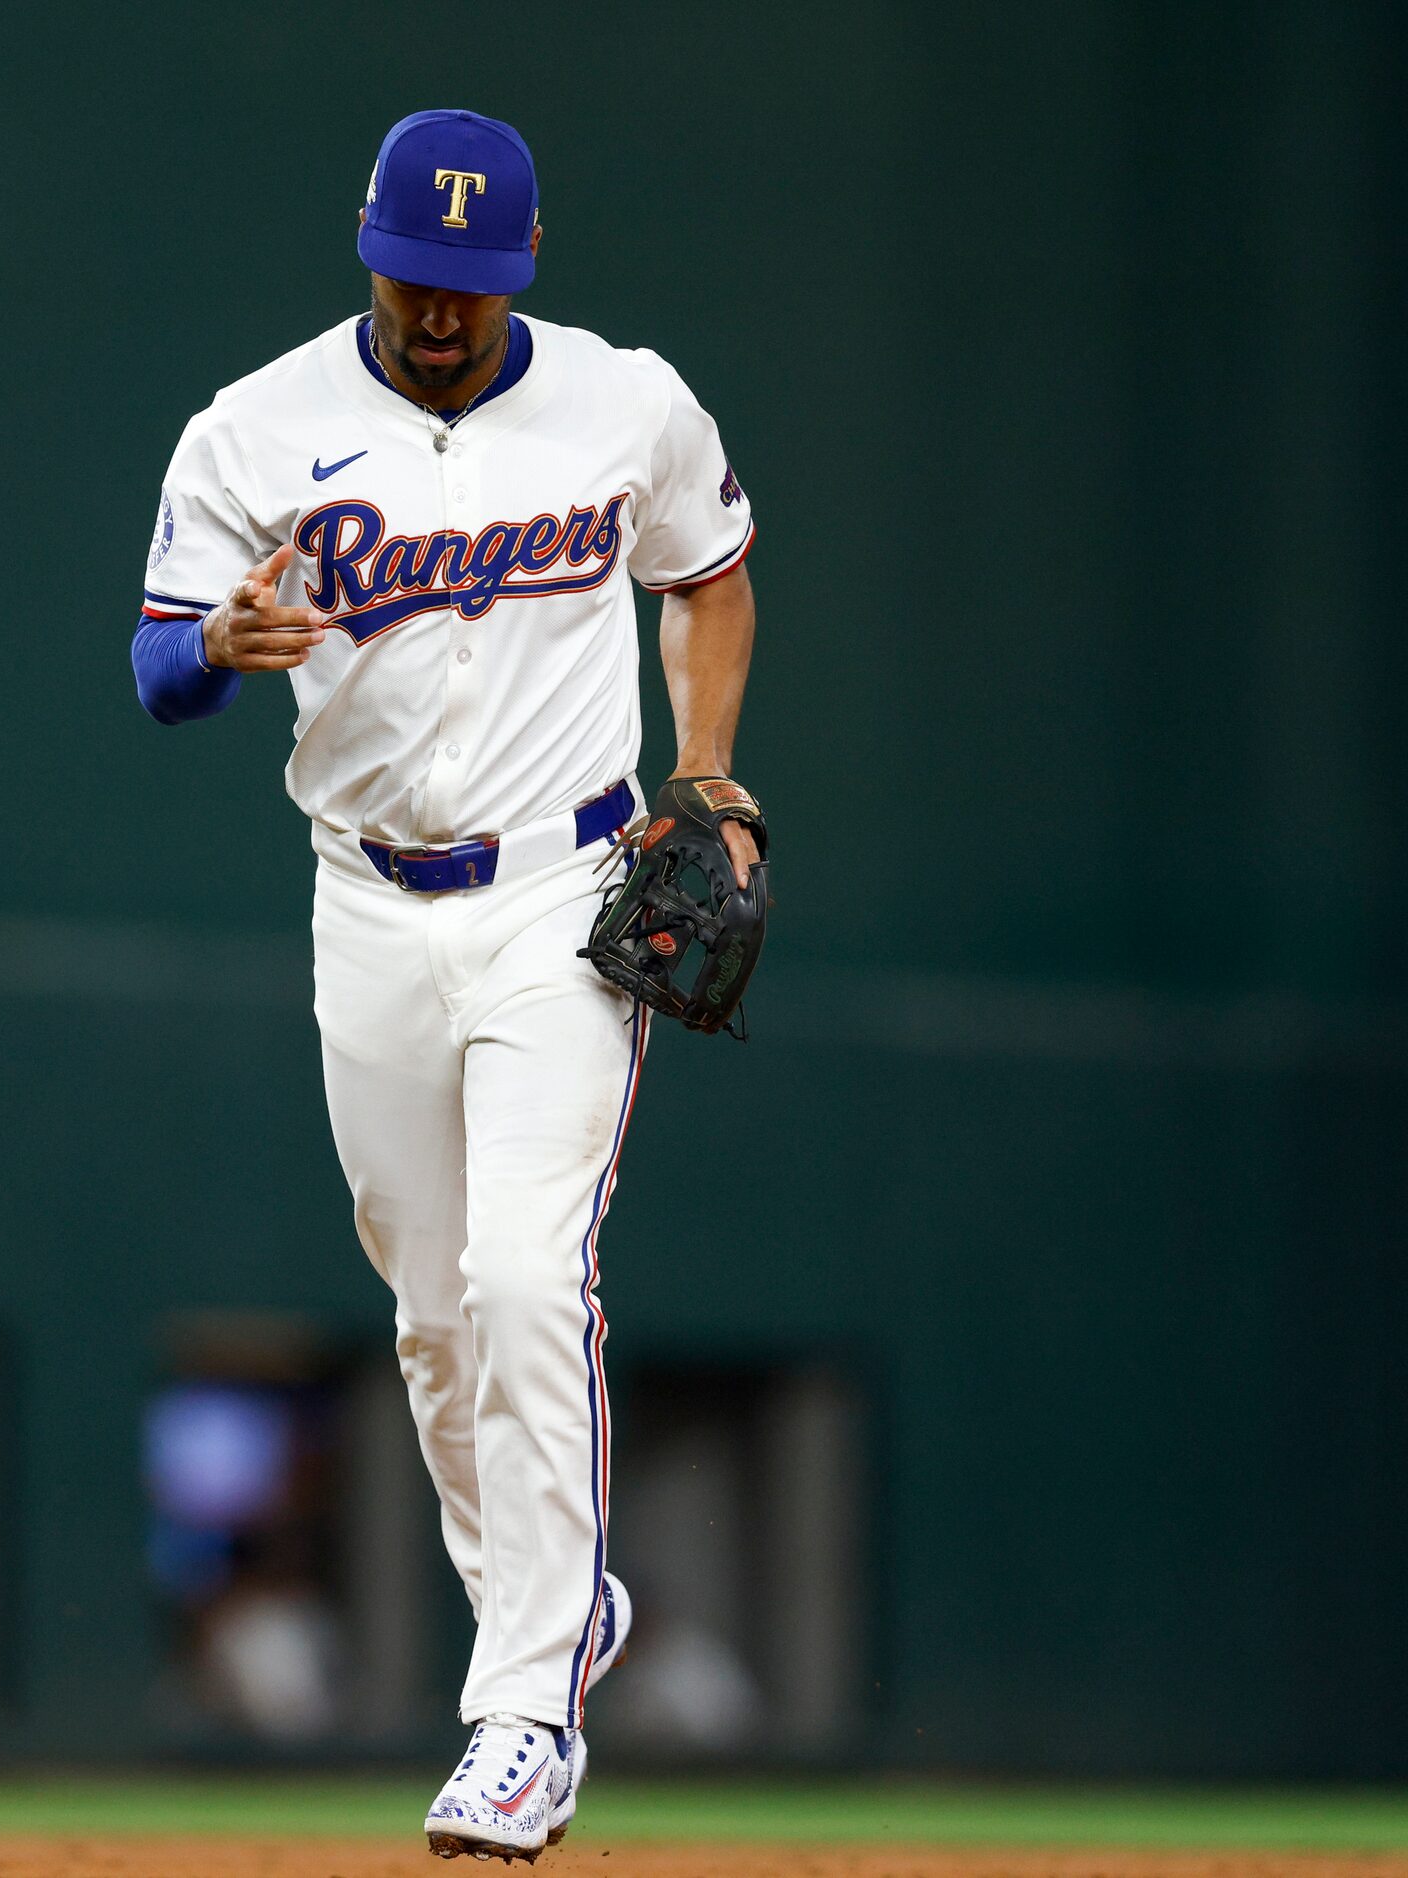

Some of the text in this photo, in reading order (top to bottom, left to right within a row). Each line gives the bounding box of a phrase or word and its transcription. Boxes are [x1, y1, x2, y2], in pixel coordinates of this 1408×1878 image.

[434, 168, 486, 229] T
[294, 492, 631, 622] Rangers
[465, 862, 479, 886] 2
